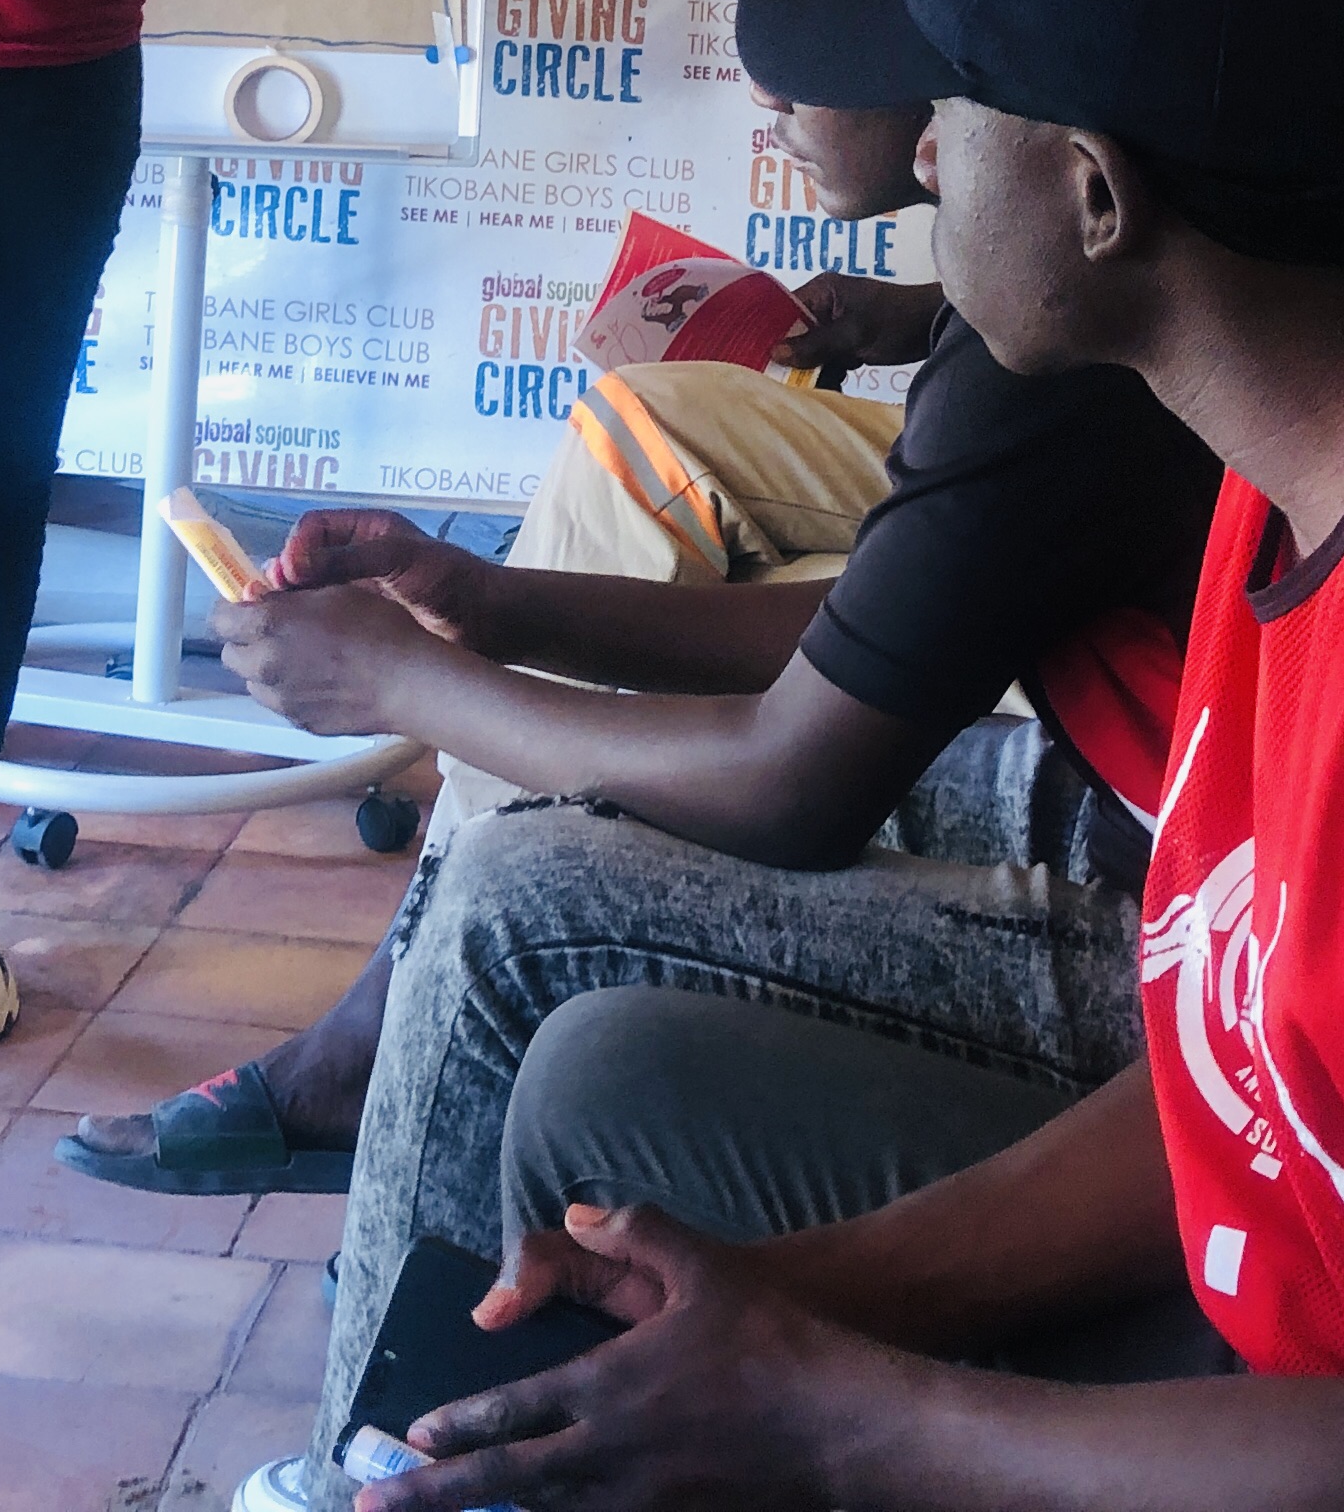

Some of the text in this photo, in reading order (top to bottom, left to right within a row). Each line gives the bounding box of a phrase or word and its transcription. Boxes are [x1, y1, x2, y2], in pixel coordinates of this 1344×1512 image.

[493, 40, 643, 103] CIRCLE
[683, 65, 742, 82] SEE ME
[544, 151, 618, 177] GIRLS
[627, 155, 695, 181] CLUB
[405, 175, 692, 215] TIKOBANE BOYS CLUB
[211, 180, 361, 245] CIRCLE
[400, 206, 555, 230] SEE ME HEAR ME
[745, 212, 898, 277] CIRCLE
[482, 271, 543, 302] global
[284, 299, 436, 331] GIRLS CLUB
[284, 334, 431, 364] BOYS CLUB
[268, 364, 293, 380] ME
[313, 367, 377, 385] BELIEVE
[382, 370, 401, 386] IN
[405, 372, 430, 389] ME
[255, 421, 341, 450] sojourns
[75, 449, 144, 474] CLUB
[380, 465, 512, 496] TIKOBANE
